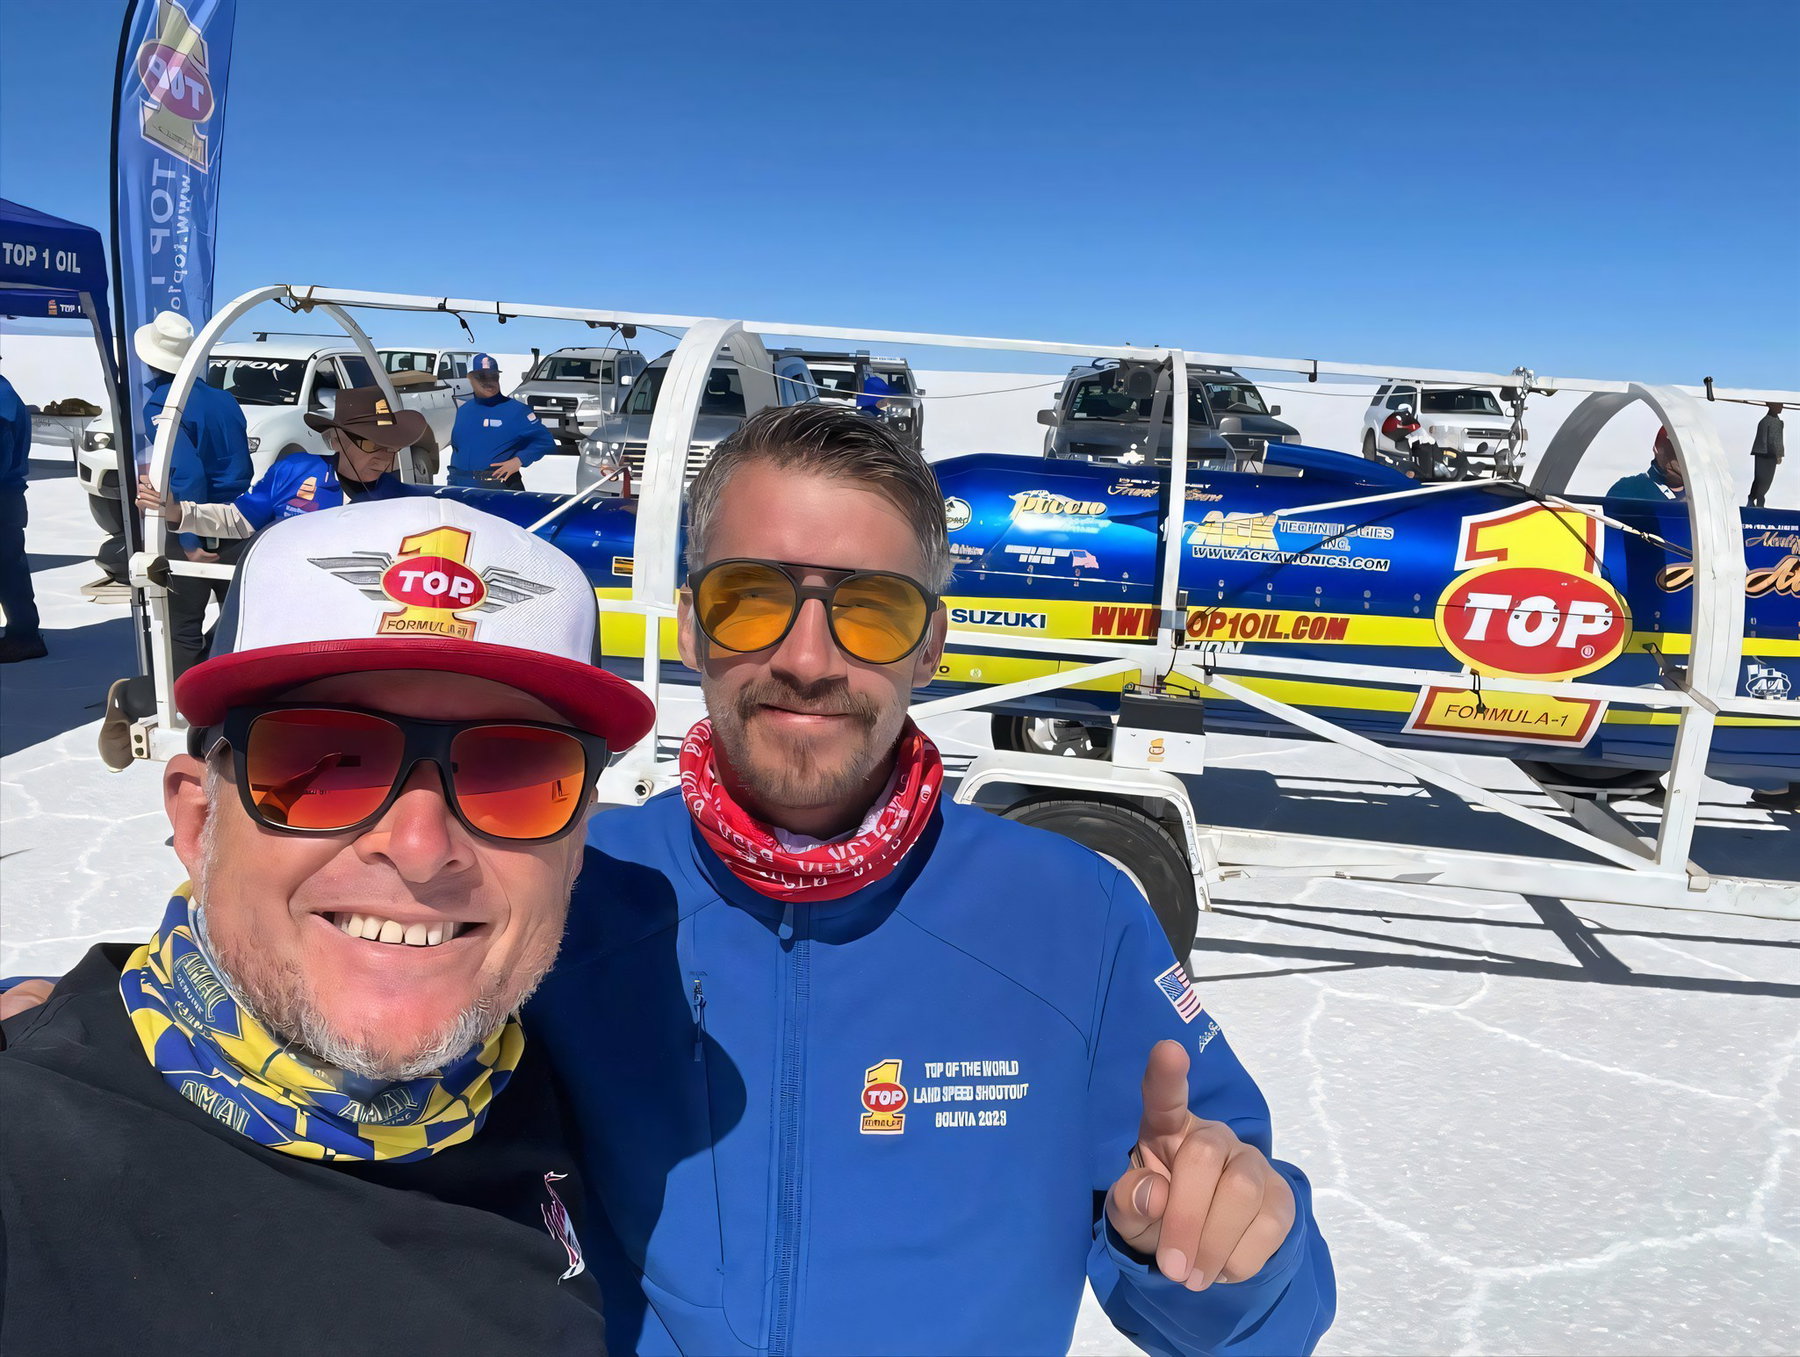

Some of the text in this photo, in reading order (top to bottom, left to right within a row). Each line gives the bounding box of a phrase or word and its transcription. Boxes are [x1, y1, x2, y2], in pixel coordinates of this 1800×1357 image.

[2, 242, 81, 274] TOP 1 OIL
[60, 304, 75, 313] TOP
[209, 359, 290, 371] RITON
[1192, 547, 1390, 571] WWW.ACKAVIONICS.COM
[398, 570, 476, 600] TOP
[951, 608, 1047, 629] SUZUKI
[1463, 592, 1614, 649] TOP
[1444, 704, 1569, 727] FORMULA-1
[925, 1060, 1019, 1079] TOP OF THE WORLD
[867, 1090, 904, 1106] TOP
[913, 1083, 1029, 1104] LAND SPEED SHOOTOUT
[935, 1111, 976, 1128] BOLIVIA
